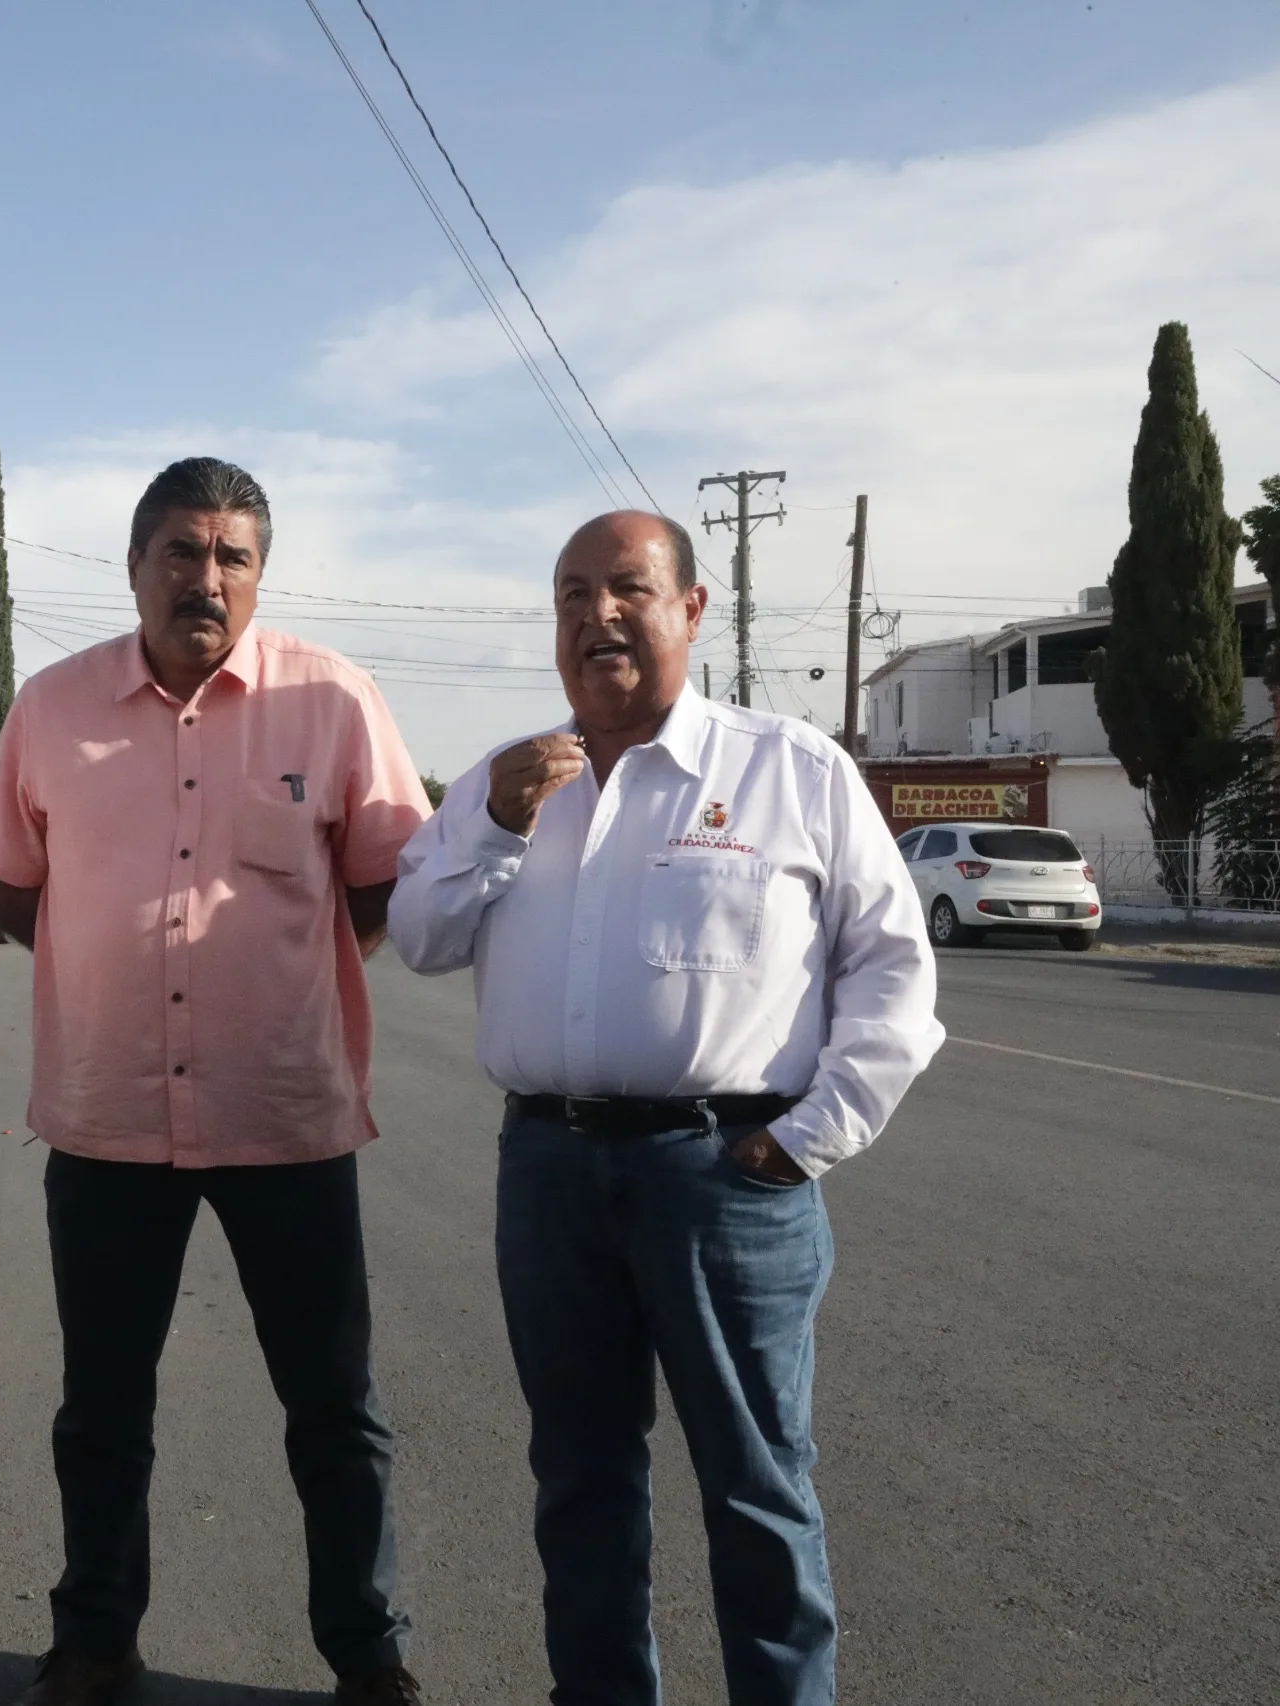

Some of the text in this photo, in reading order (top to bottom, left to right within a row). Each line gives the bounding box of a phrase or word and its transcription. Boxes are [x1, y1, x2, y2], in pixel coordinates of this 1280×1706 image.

[898, 788, 996, 801] BARBACOA
[894, 803, 999, 816] DE CACHETE
